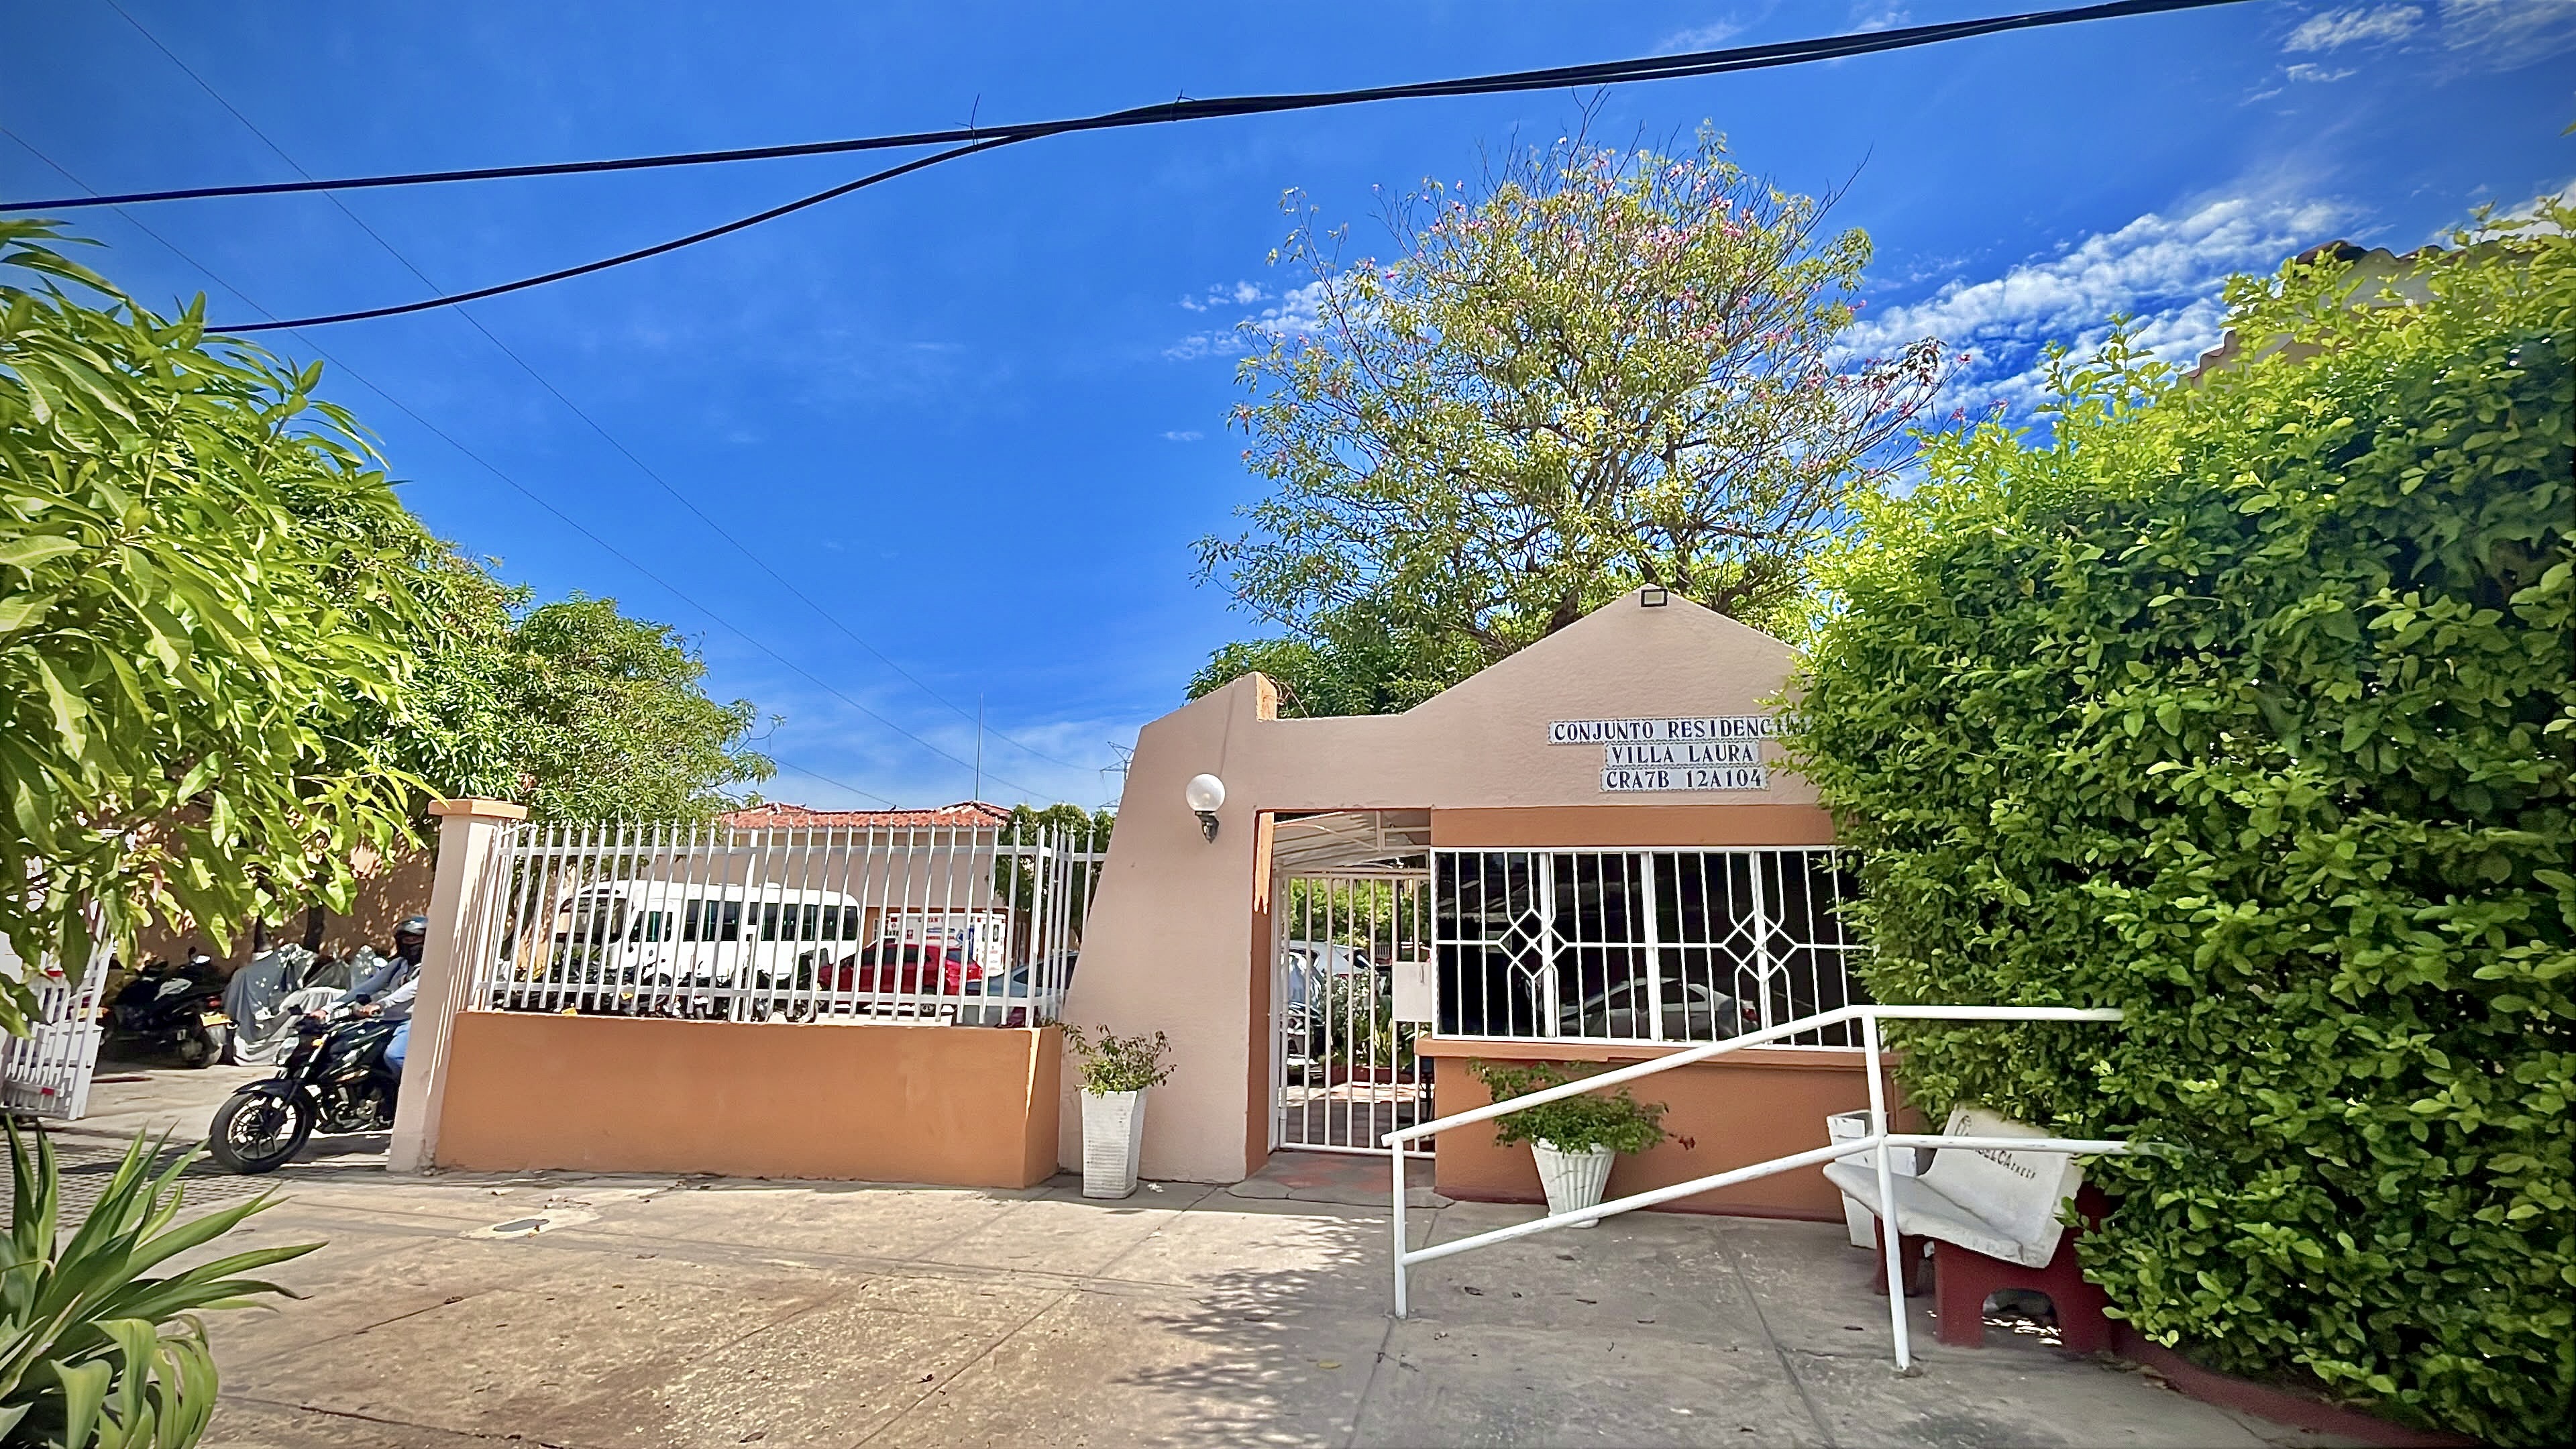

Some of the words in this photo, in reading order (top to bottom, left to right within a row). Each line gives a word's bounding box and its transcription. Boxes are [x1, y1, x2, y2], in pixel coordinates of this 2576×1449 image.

[1554, 721, 1654, 741] CONJUNTO
[1611, 745, 1674, 764] VILLA
[1688, 744, 1754, 763] LAURA
[1606, 770, 1670, 790] CRA7B
[1687, 769, 1762, 788] 12A104
